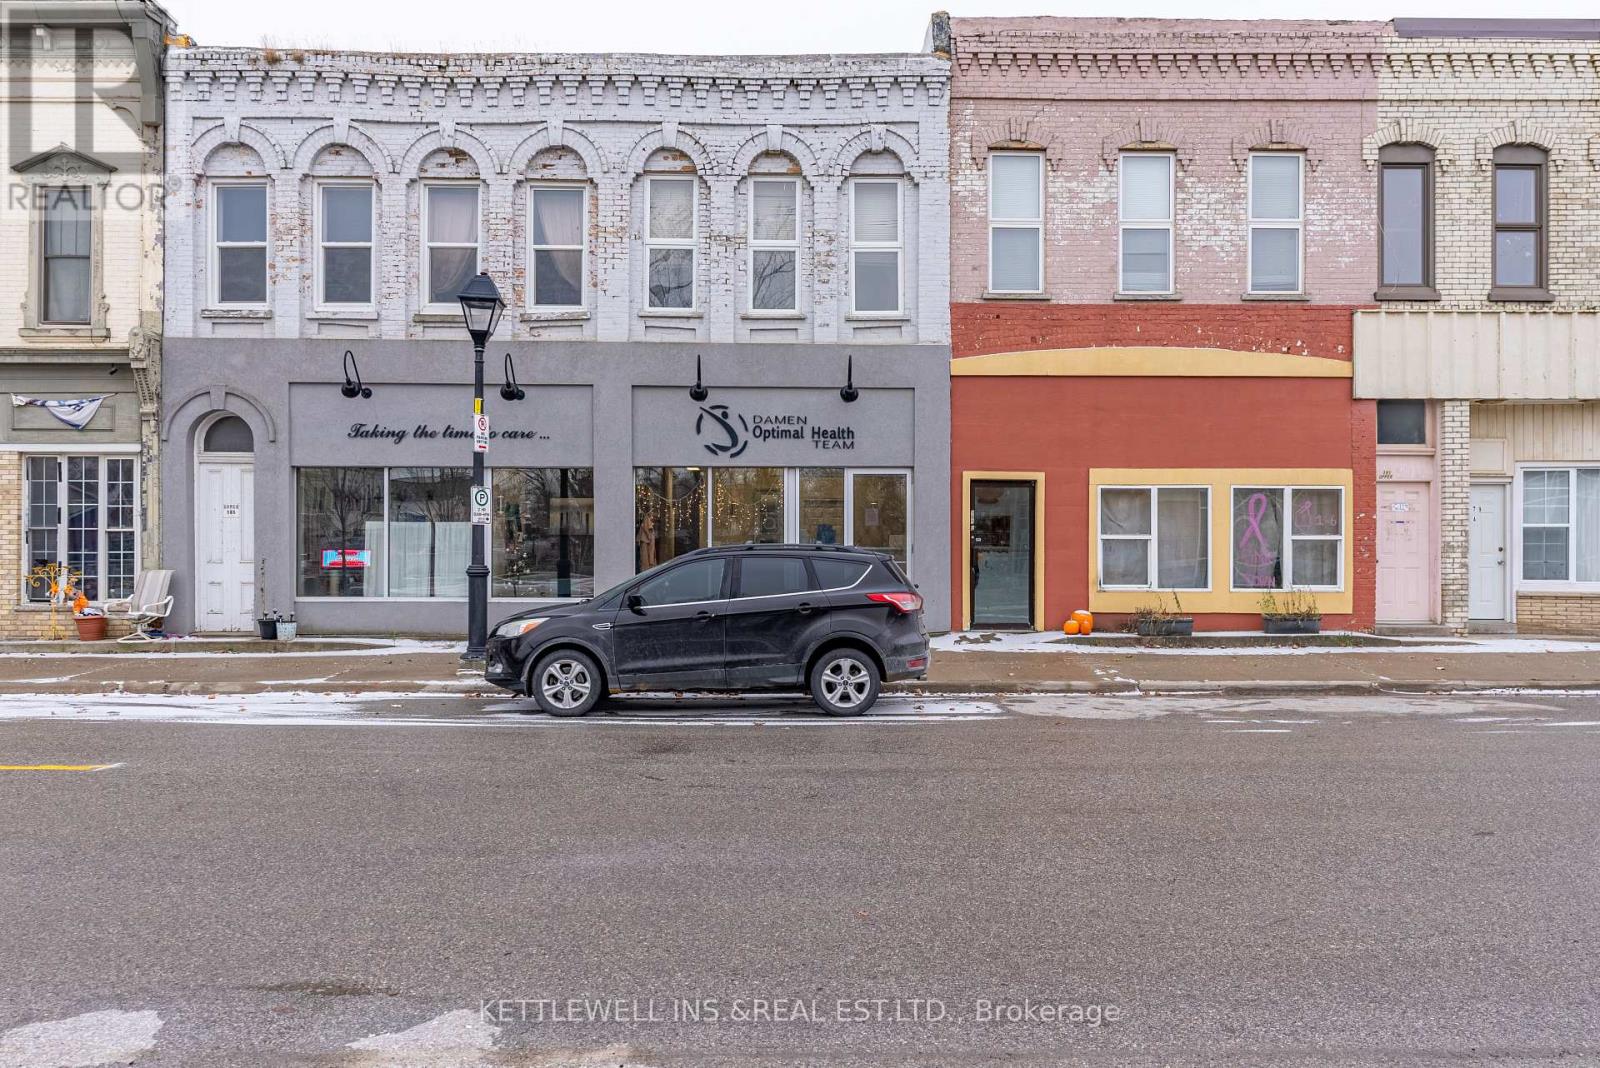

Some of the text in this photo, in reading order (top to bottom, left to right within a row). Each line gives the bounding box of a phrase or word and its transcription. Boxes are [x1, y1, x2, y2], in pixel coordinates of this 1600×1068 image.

[753, 415, 808, 425] DAMEN
[347, 422, 408, 445] Taking
[413, 424, 441, 439] the
[501, 429, 537, 439] care
[752, 425, 855, 442] Optimal Health
[812, 440, 855, 450] TEAM
